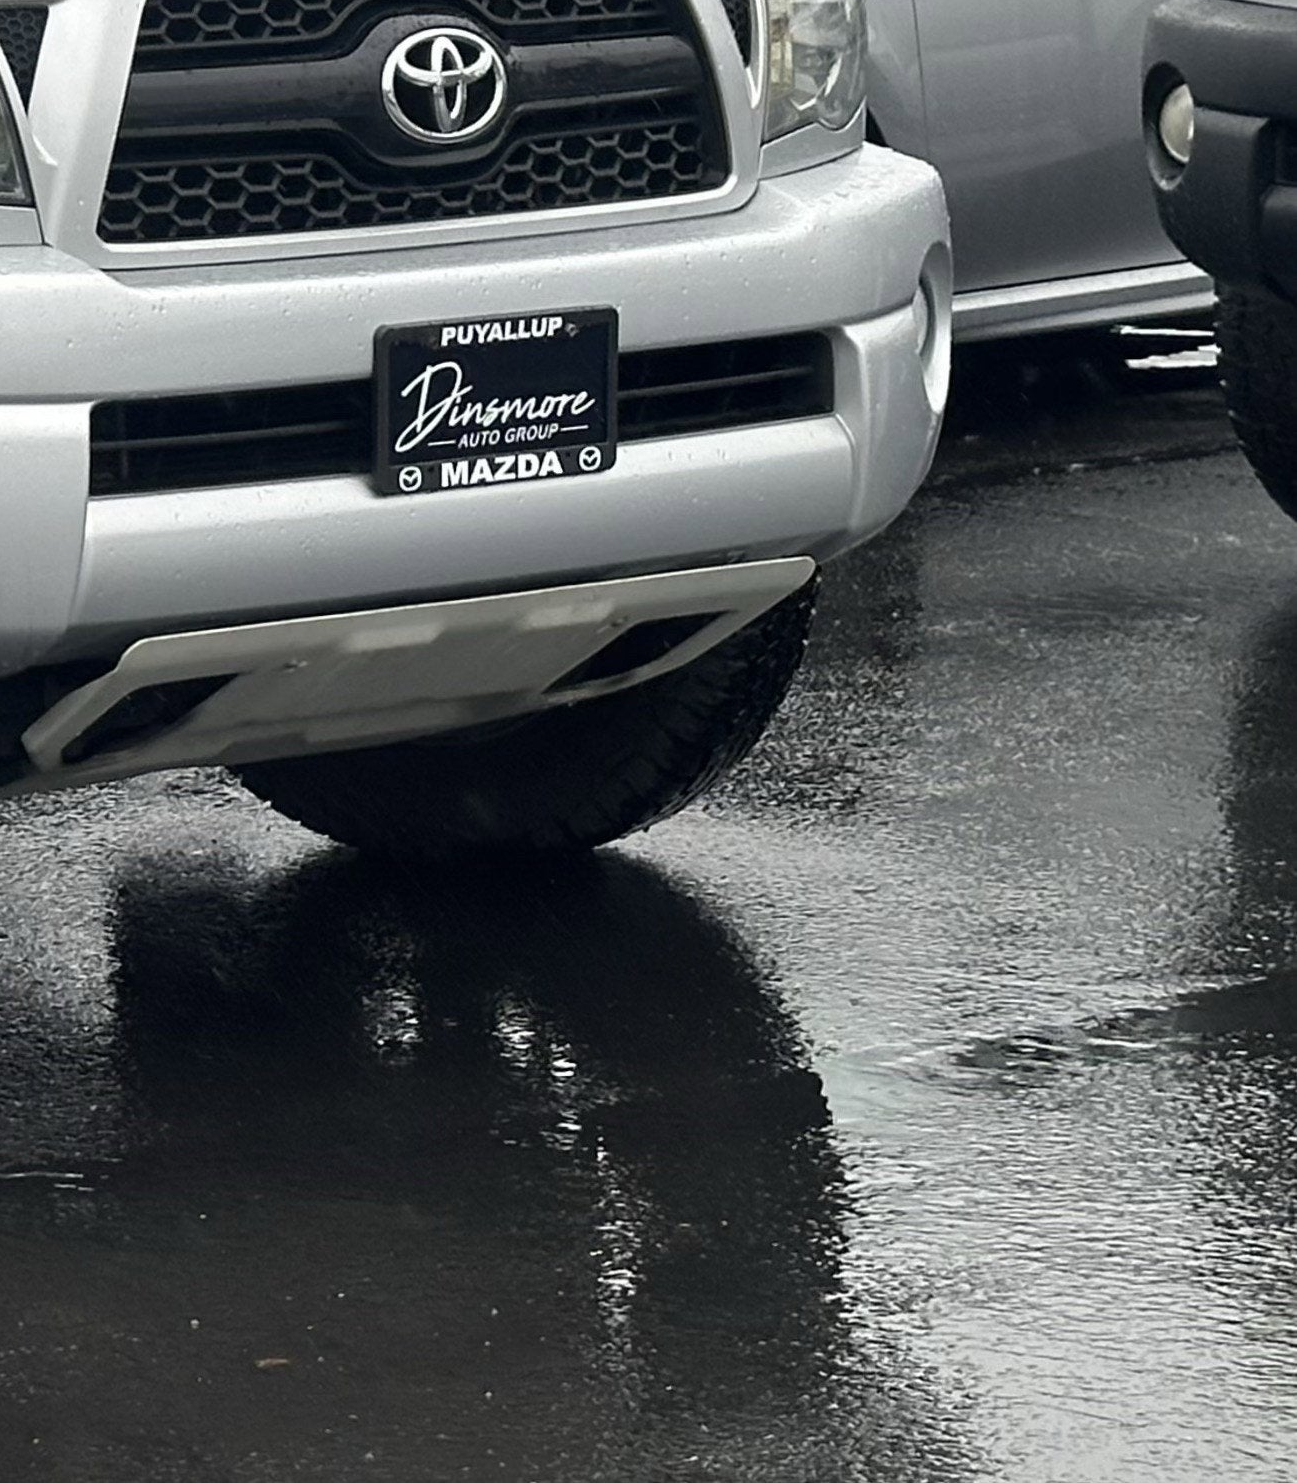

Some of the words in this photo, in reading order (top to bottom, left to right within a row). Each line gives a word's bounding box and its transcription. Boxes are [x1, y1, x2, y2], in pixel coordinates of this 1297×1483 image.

[440, 316, 563, 347] PUYALLUP
[394, 361, 596, 453] Dinsmore
[458, 428, 501, 449] AUTO
[504, 423, 560, 444] GROUP
[440, 450, 564, 488] MAZDA
